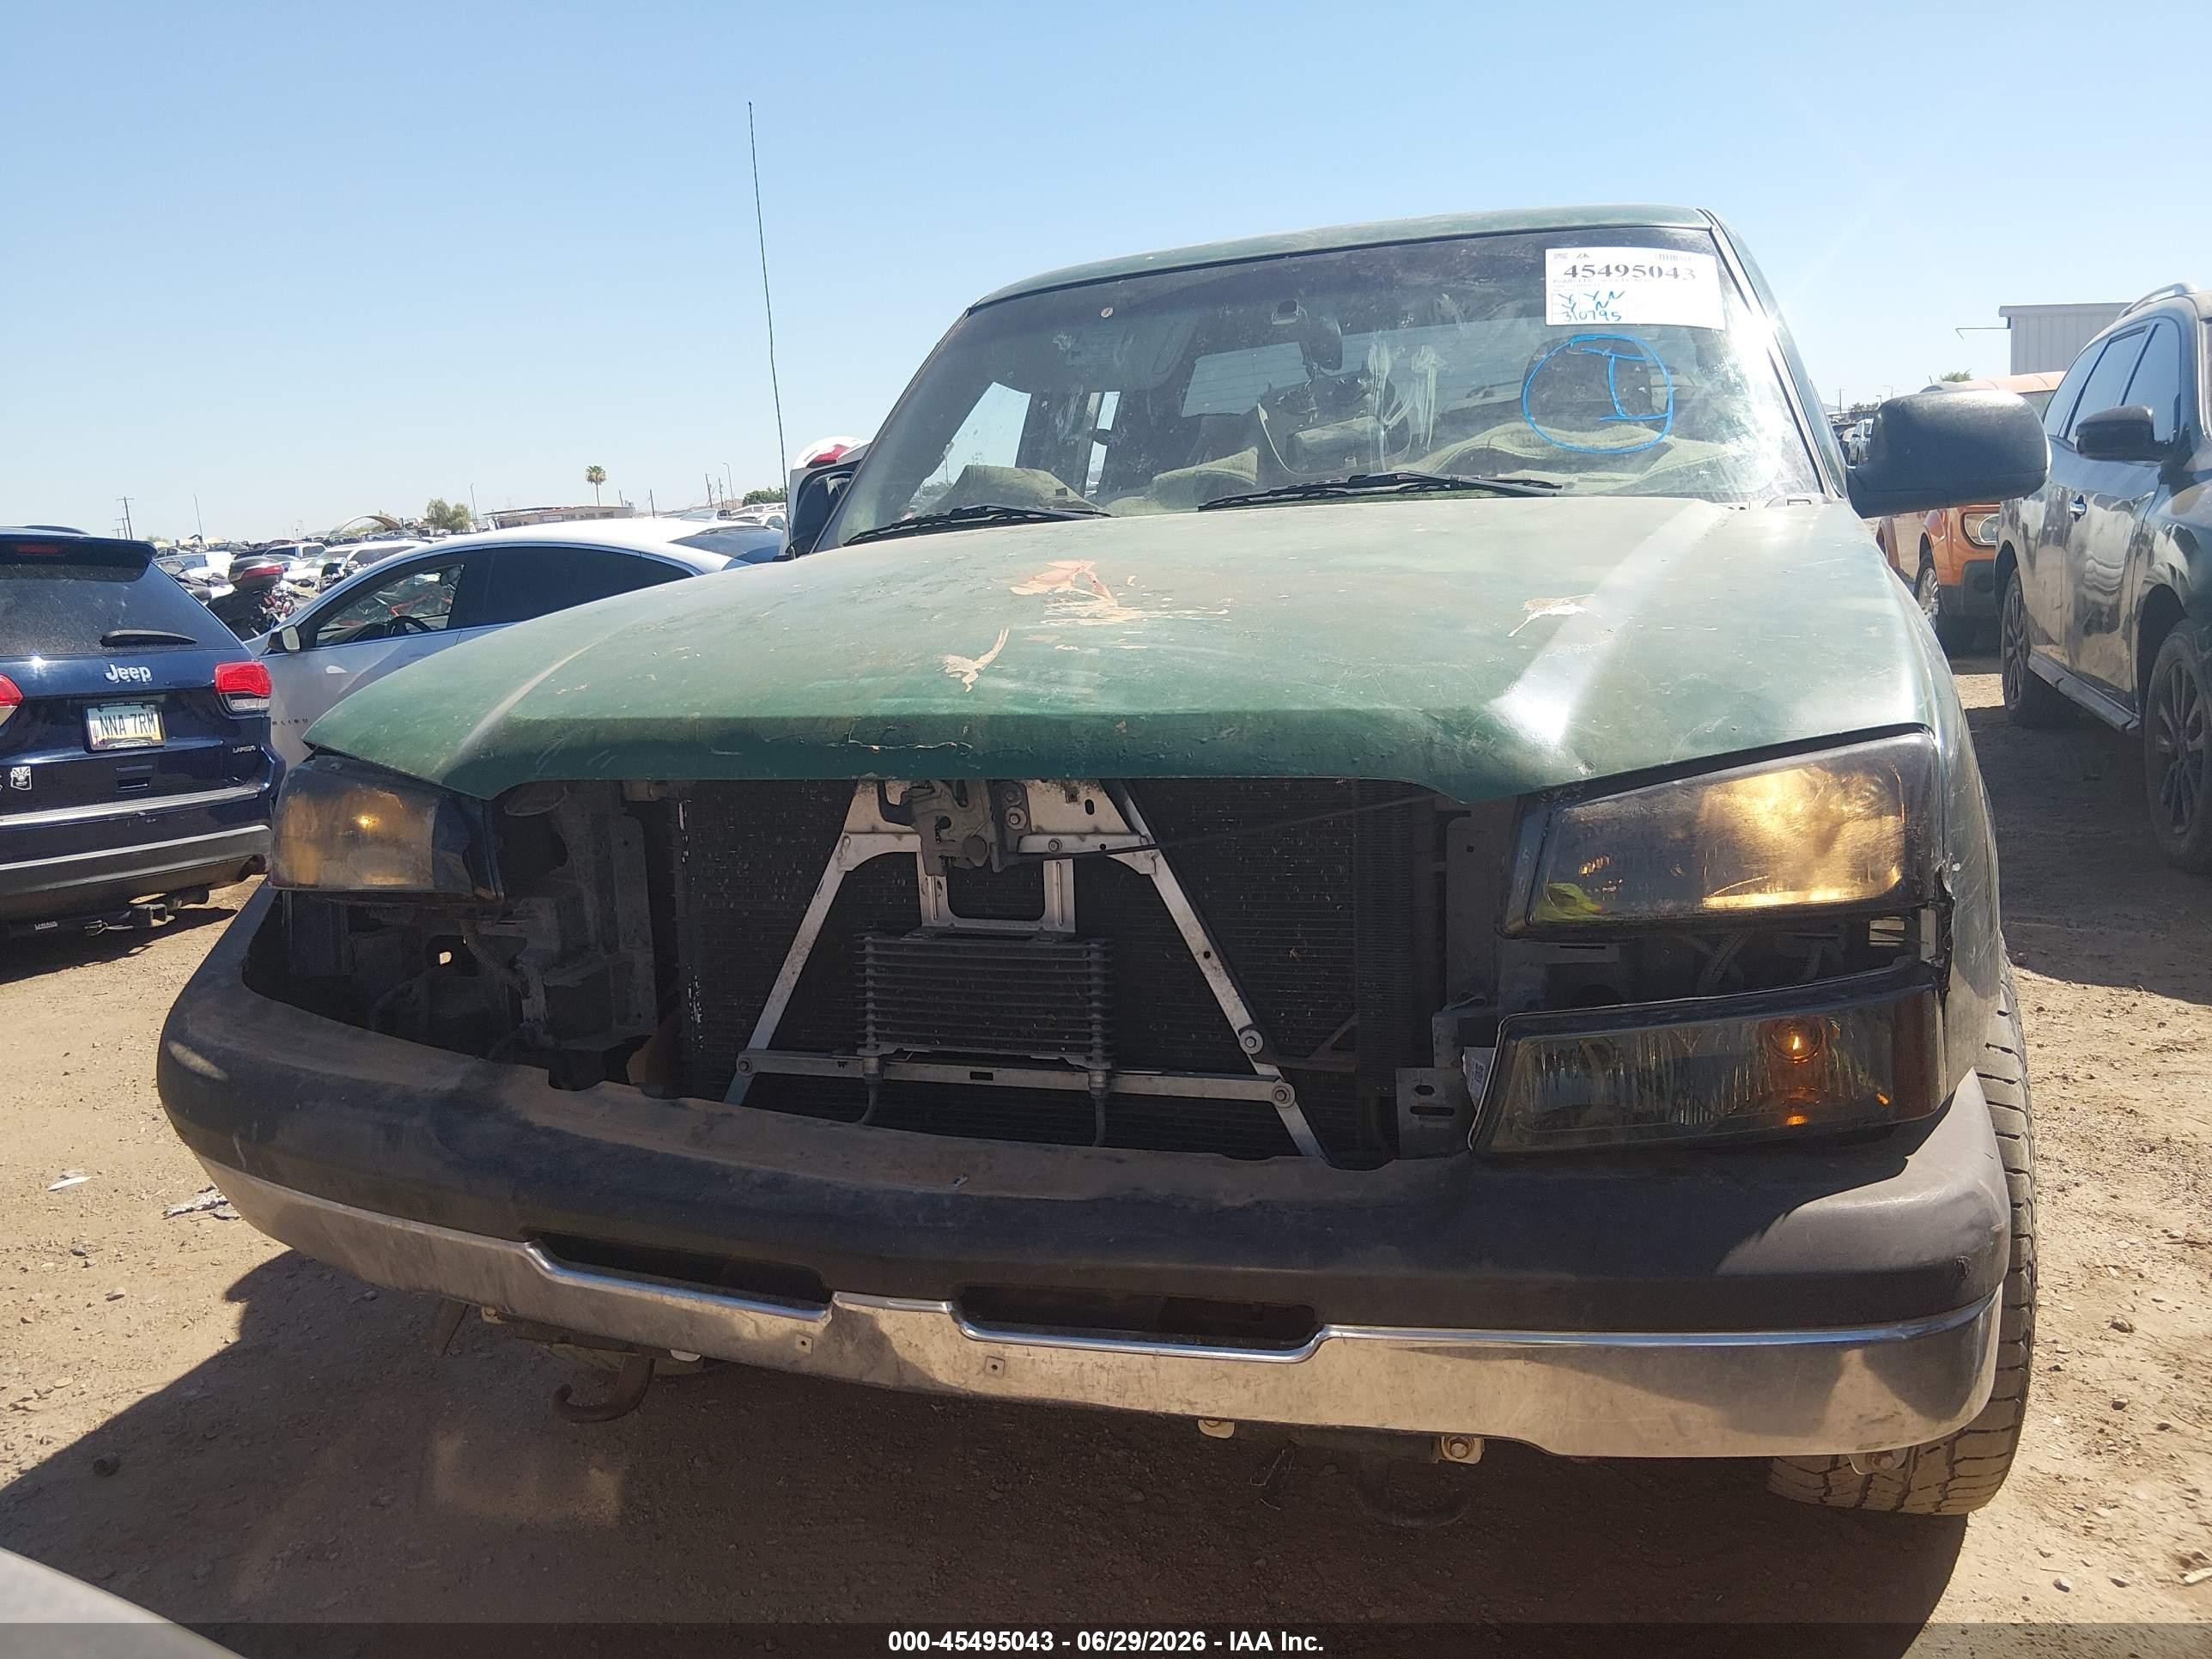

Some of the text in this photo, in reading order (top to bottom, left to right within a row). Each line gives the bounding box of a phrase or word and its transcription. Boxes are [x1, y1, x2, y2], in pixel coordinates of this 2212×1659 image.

[1564, 264, 1697, 281] 45495043
[105, 663, 152, 684] Jeep
[99, 713, 157, 737] NNA 7RM
